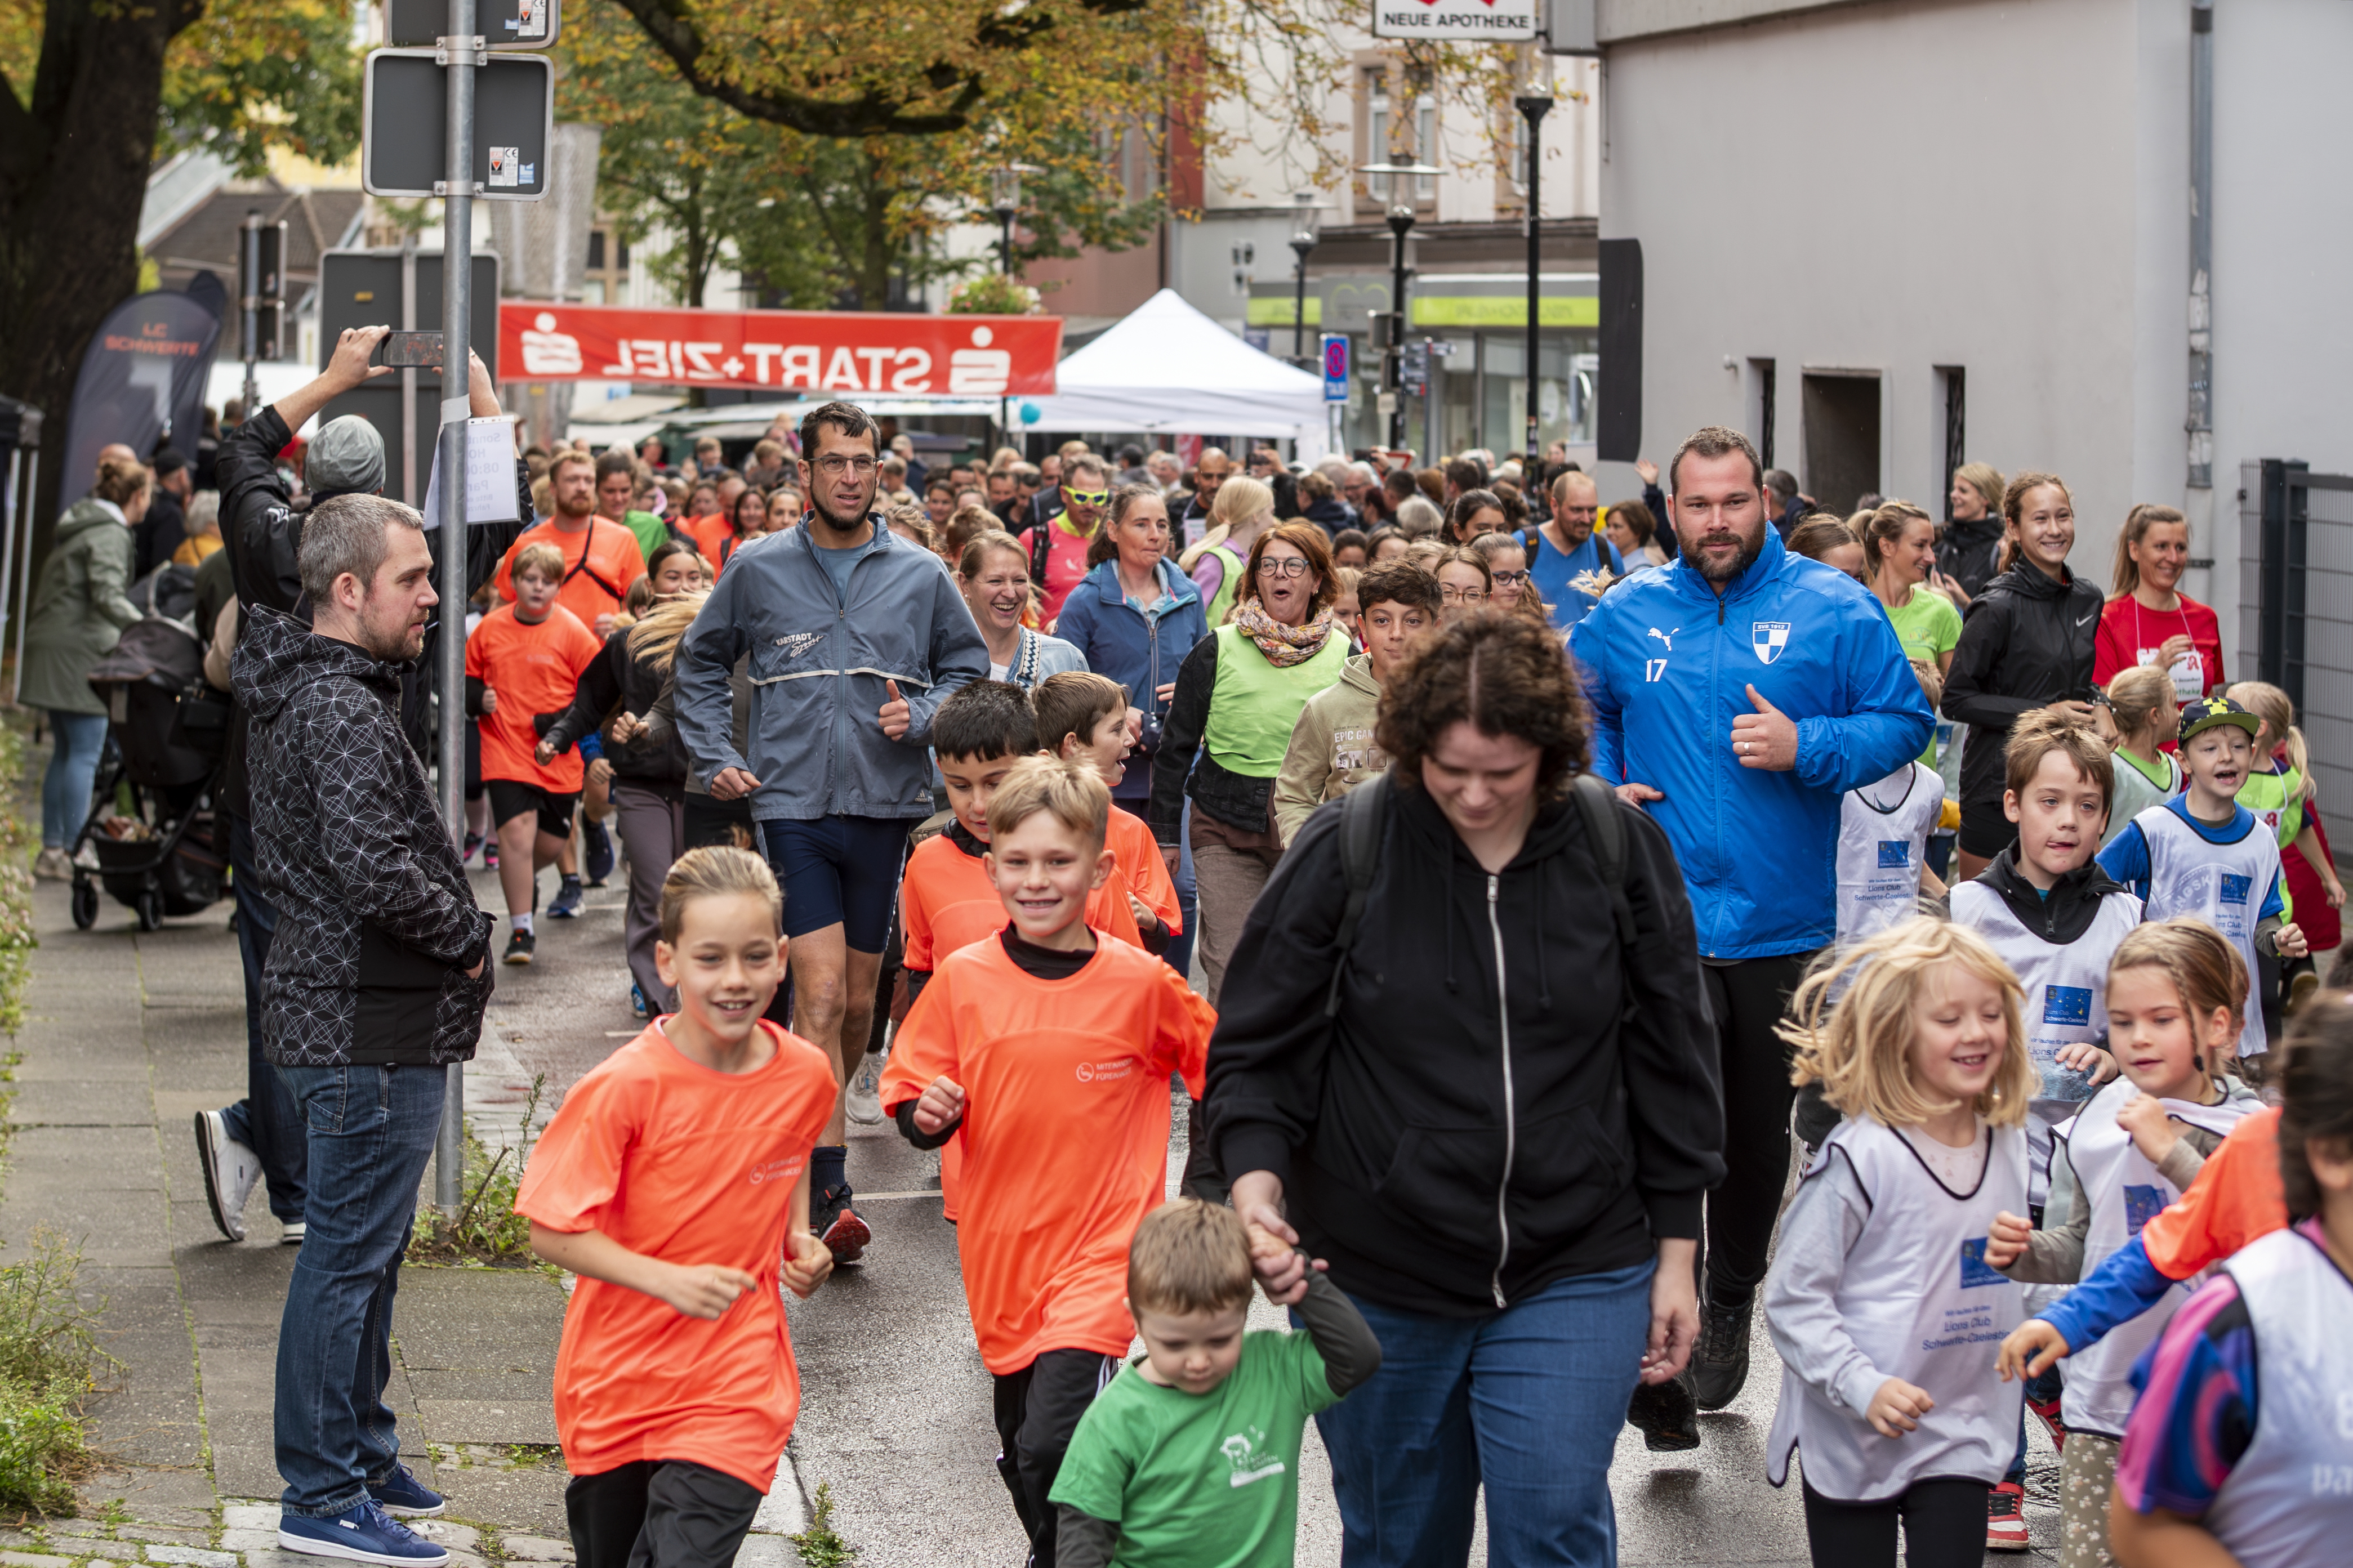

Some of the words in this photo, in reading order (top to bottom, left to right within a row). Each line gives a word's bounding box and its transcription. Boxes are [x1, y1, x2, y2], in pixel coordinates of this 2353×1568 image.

[1384, 12, 1430, 26] NEUE
[1437, 14, 1529, 29] APOTHEKE
[776, 632, 812, 646] KARSTADT
[790, 635, 824, 658] Sport
[1645, 659, 1668, 682] 17
[1334, 730, 1354, 743] EPIC
[2028, 1046, 2051, 1056] Lions
[1944, 1320, 1968, 1332] Lions
[1970, 1316, 1991, 1328] Club
